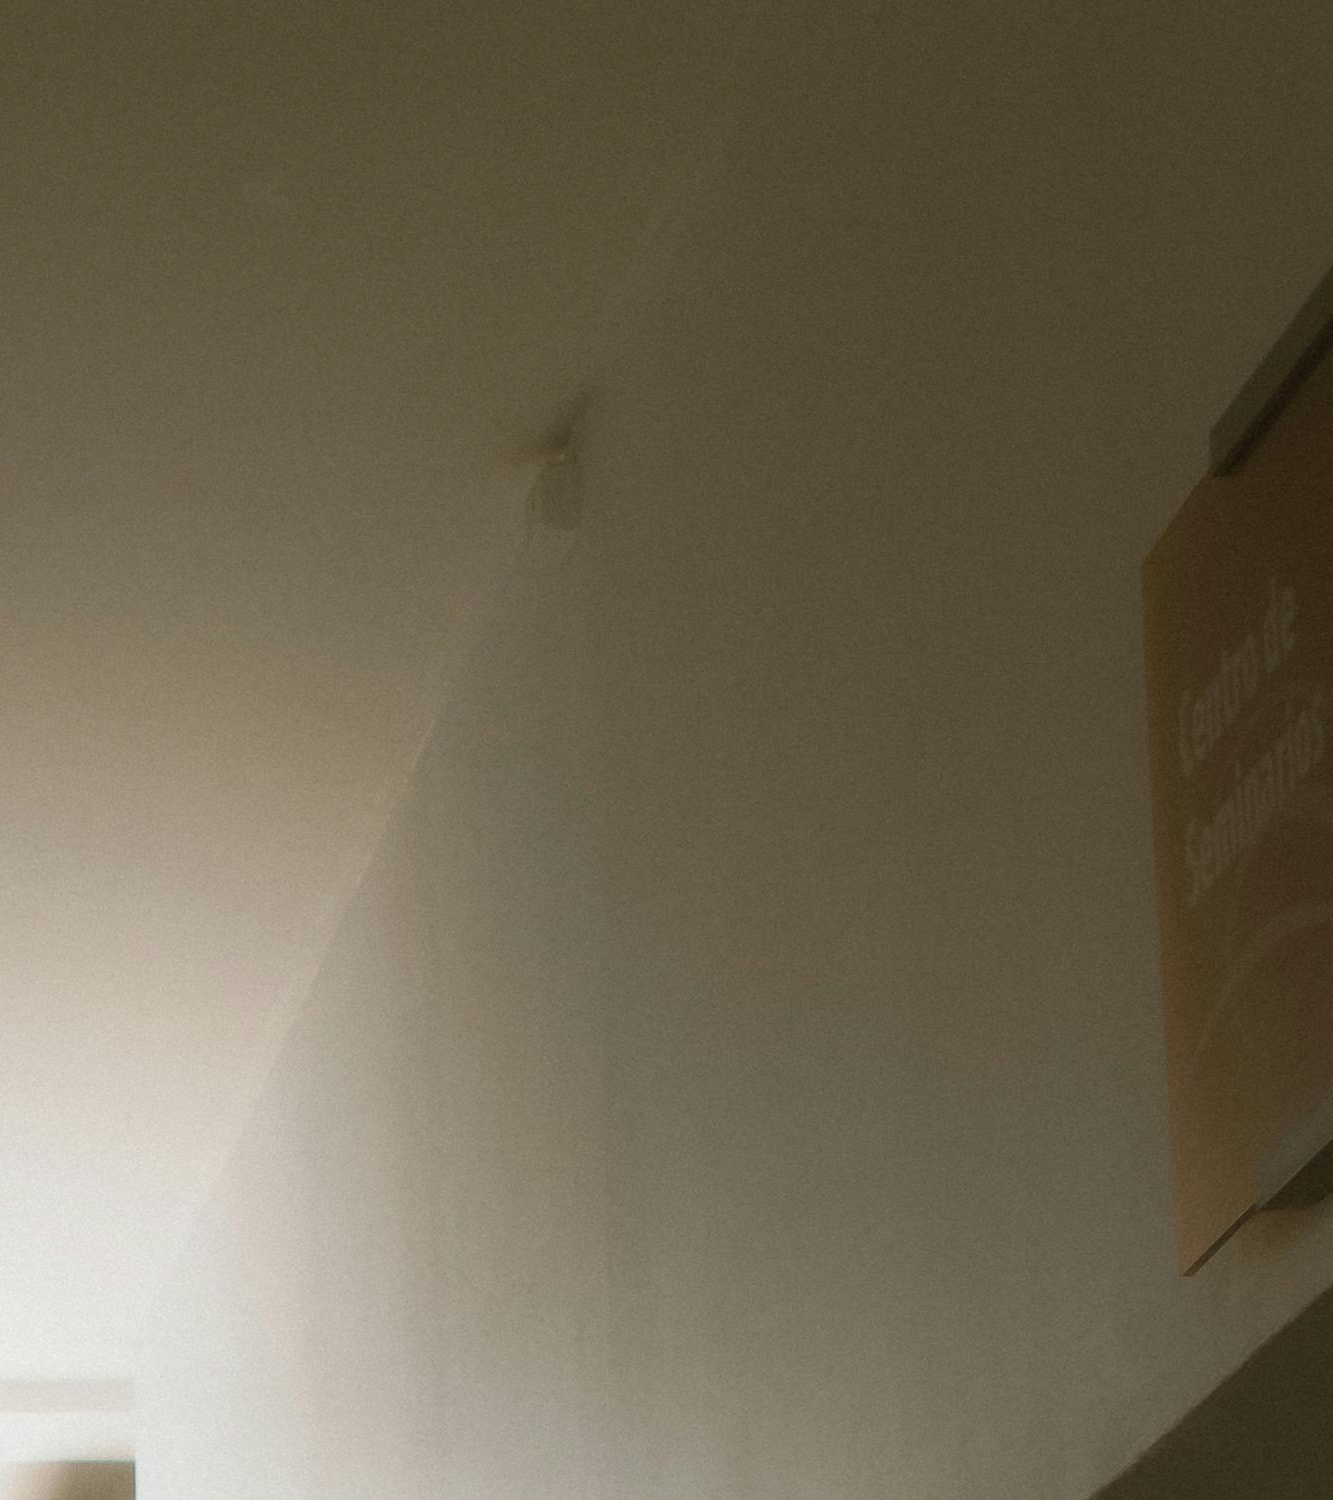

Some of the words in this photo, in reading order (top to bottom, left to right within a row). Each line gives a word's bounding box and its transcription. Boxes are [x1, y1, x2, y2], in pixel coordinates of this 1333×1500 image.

[1178, 632, 1260, 777] Centro
[1262, 574, 1298, 672] de
[1184, 688, 1326, 909] Seminarios
